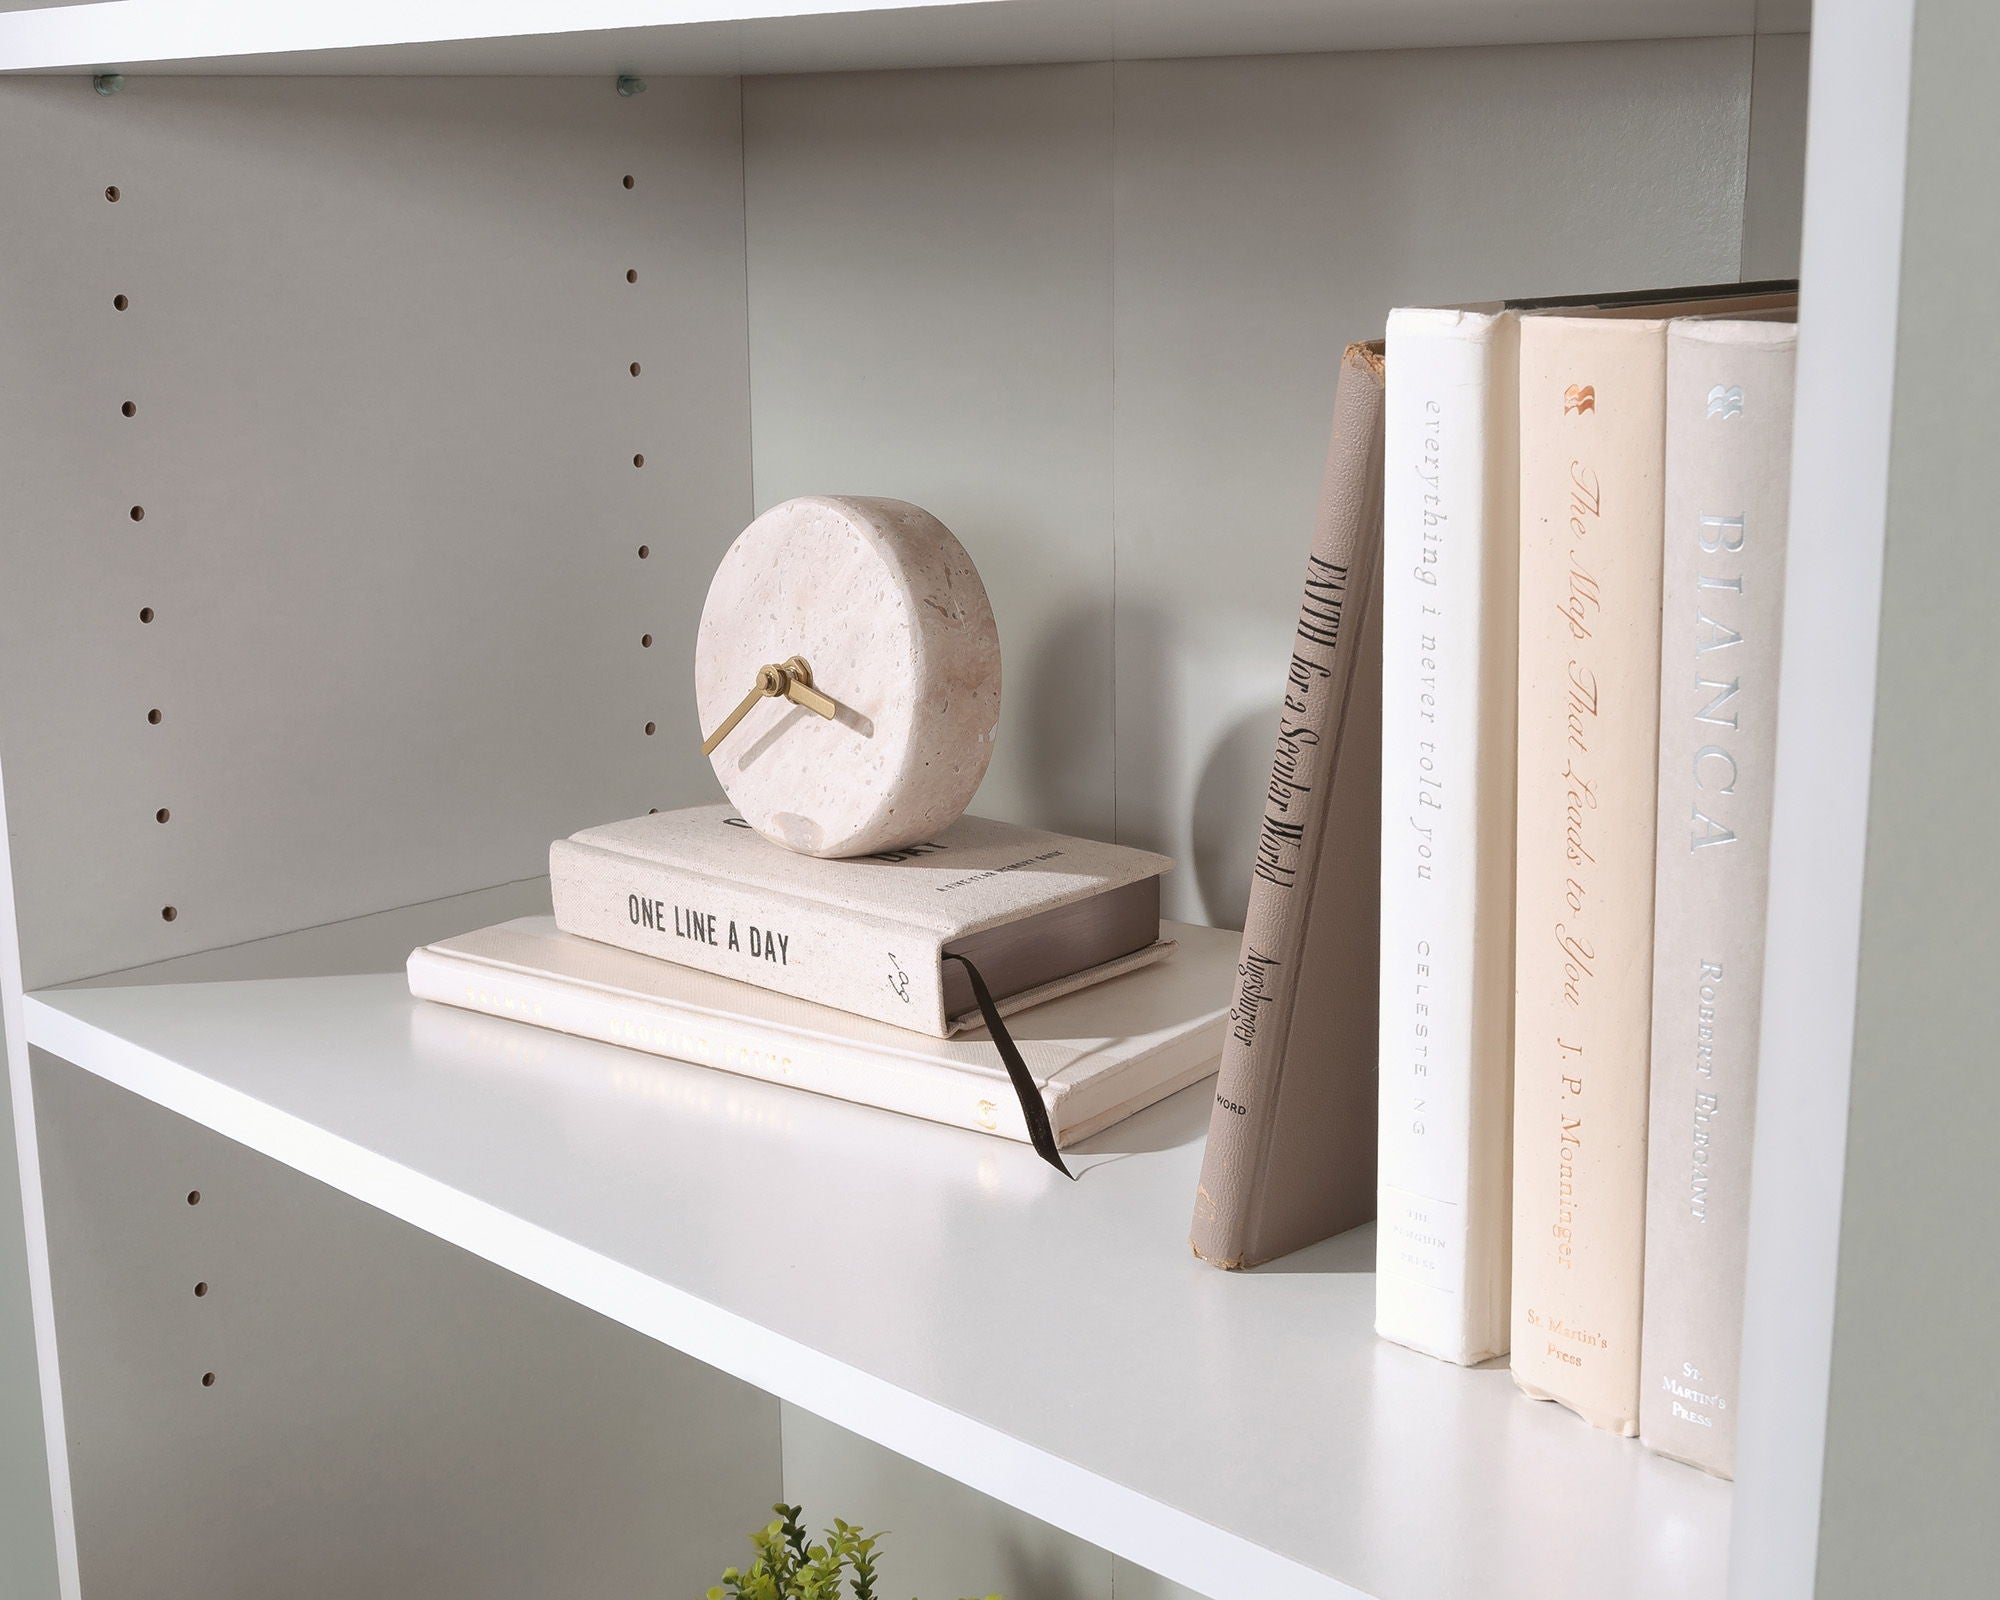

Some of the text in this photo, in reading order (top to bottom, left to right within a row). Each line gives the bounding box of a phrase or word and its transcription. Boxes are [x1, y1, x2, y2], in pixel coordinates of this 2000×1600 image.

[1409, 400, 1448, 881] everything i never told you
[1689, 509, 1747, 855] BIANCA
[1254, 555, 1348, 888] FAITH for a Secular World
[1555, 460, 1601, 1010] The Map That Leads to You
[628, 894, 790, 966] ONE LINE A DAY
[1230, 947, 1282, 1047] Augsburger
[1411, 940, 1430, 1137] CELESTE NG
[1696, 958, 1723, 1080] ROBERT
[1216, 1093, 1247, 1116] WORD
[1552, 1037, 1583, 1271] J. P. Monninger
[1547, 1315, 1608, 1350] Martin's
[1547, 1342, 1583, 1368] Press
